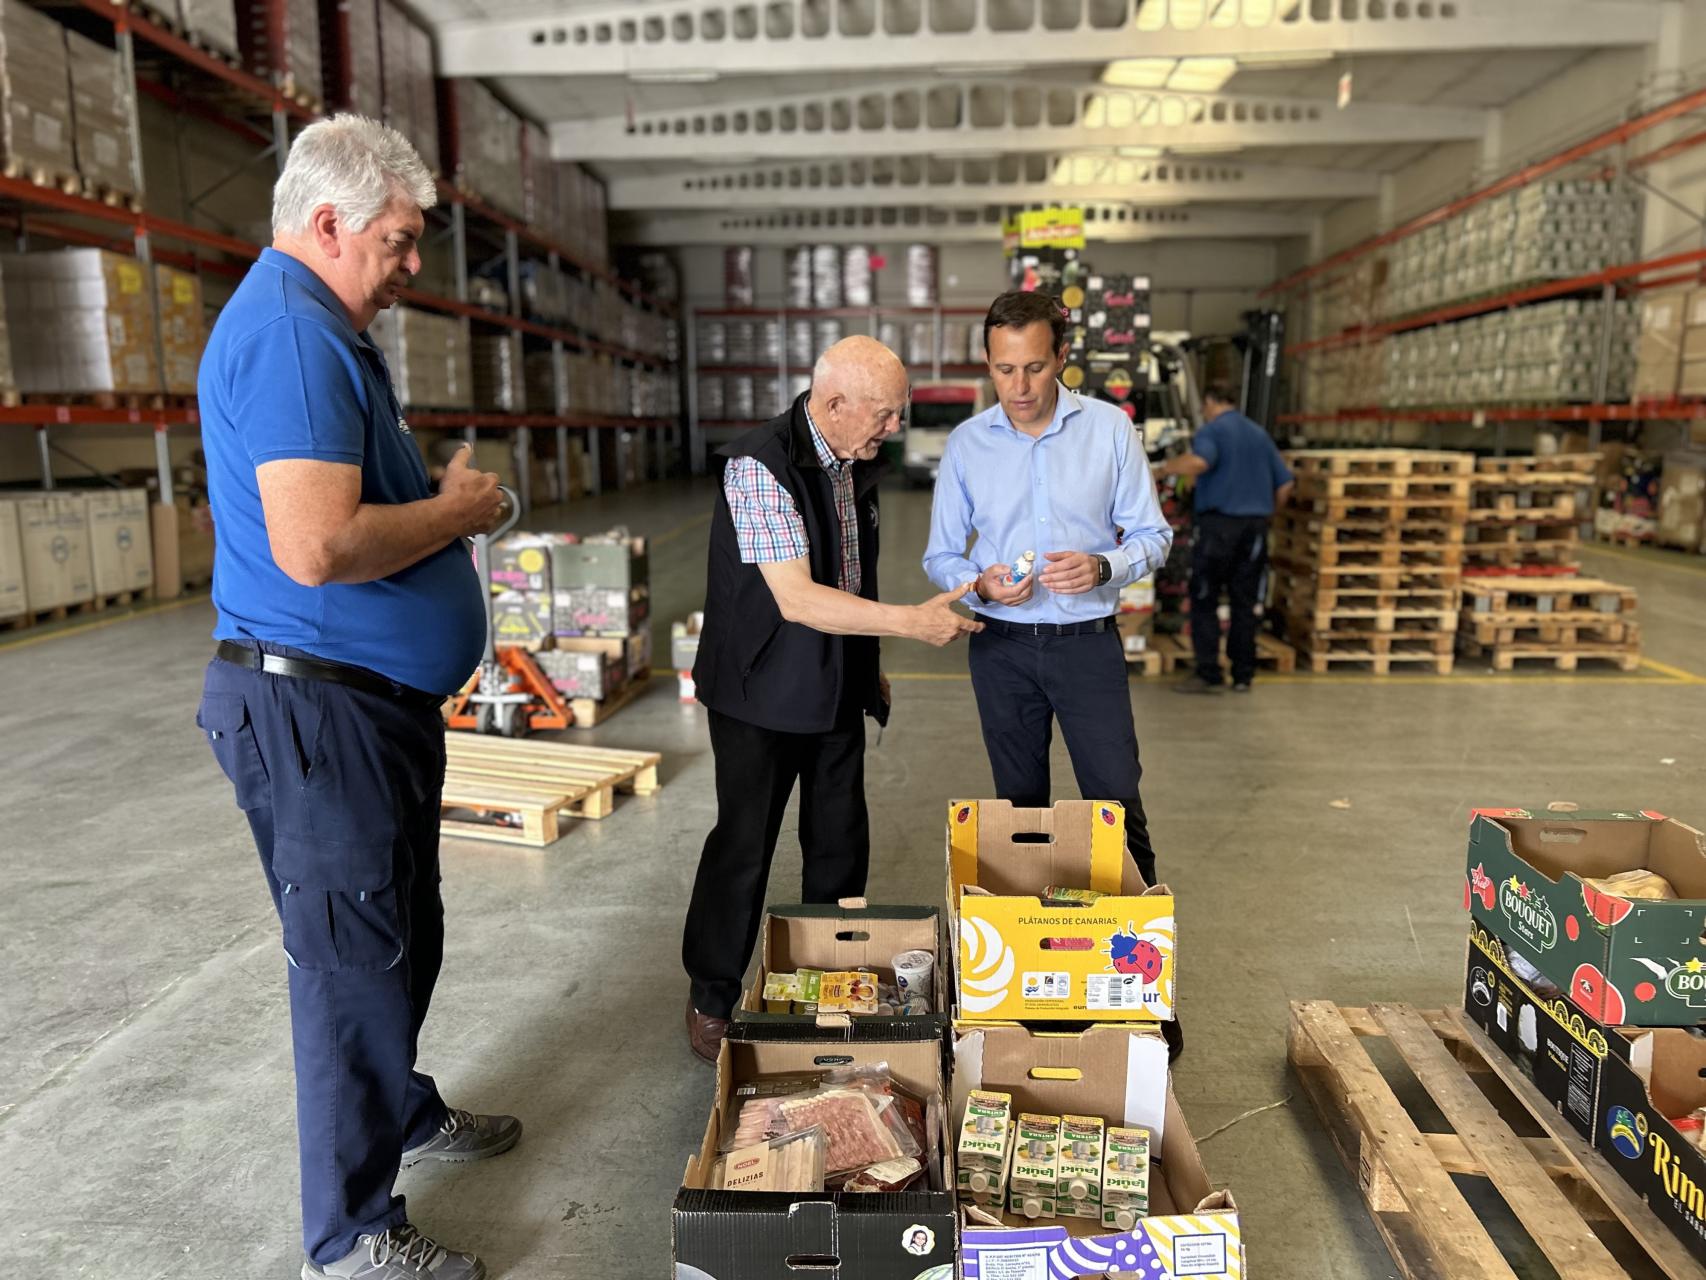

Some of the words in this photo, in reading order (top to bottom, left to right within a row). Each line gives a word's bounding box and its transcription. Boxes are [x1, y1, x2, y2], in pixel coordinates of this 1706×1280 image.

[1018, 915, 1060, 925] PLÁTANOS
[1062, 917, 1073, 925] DE
[1075, 917, 1117, 925] CANARIAS
[1505, 890, 1552, 938] BOUQUET
[1517, 920, 1534, 940] Stars
[727, 1171, 764, 1187] DELIZIAS
[1649, 1131, 1706, 1222] Rim
